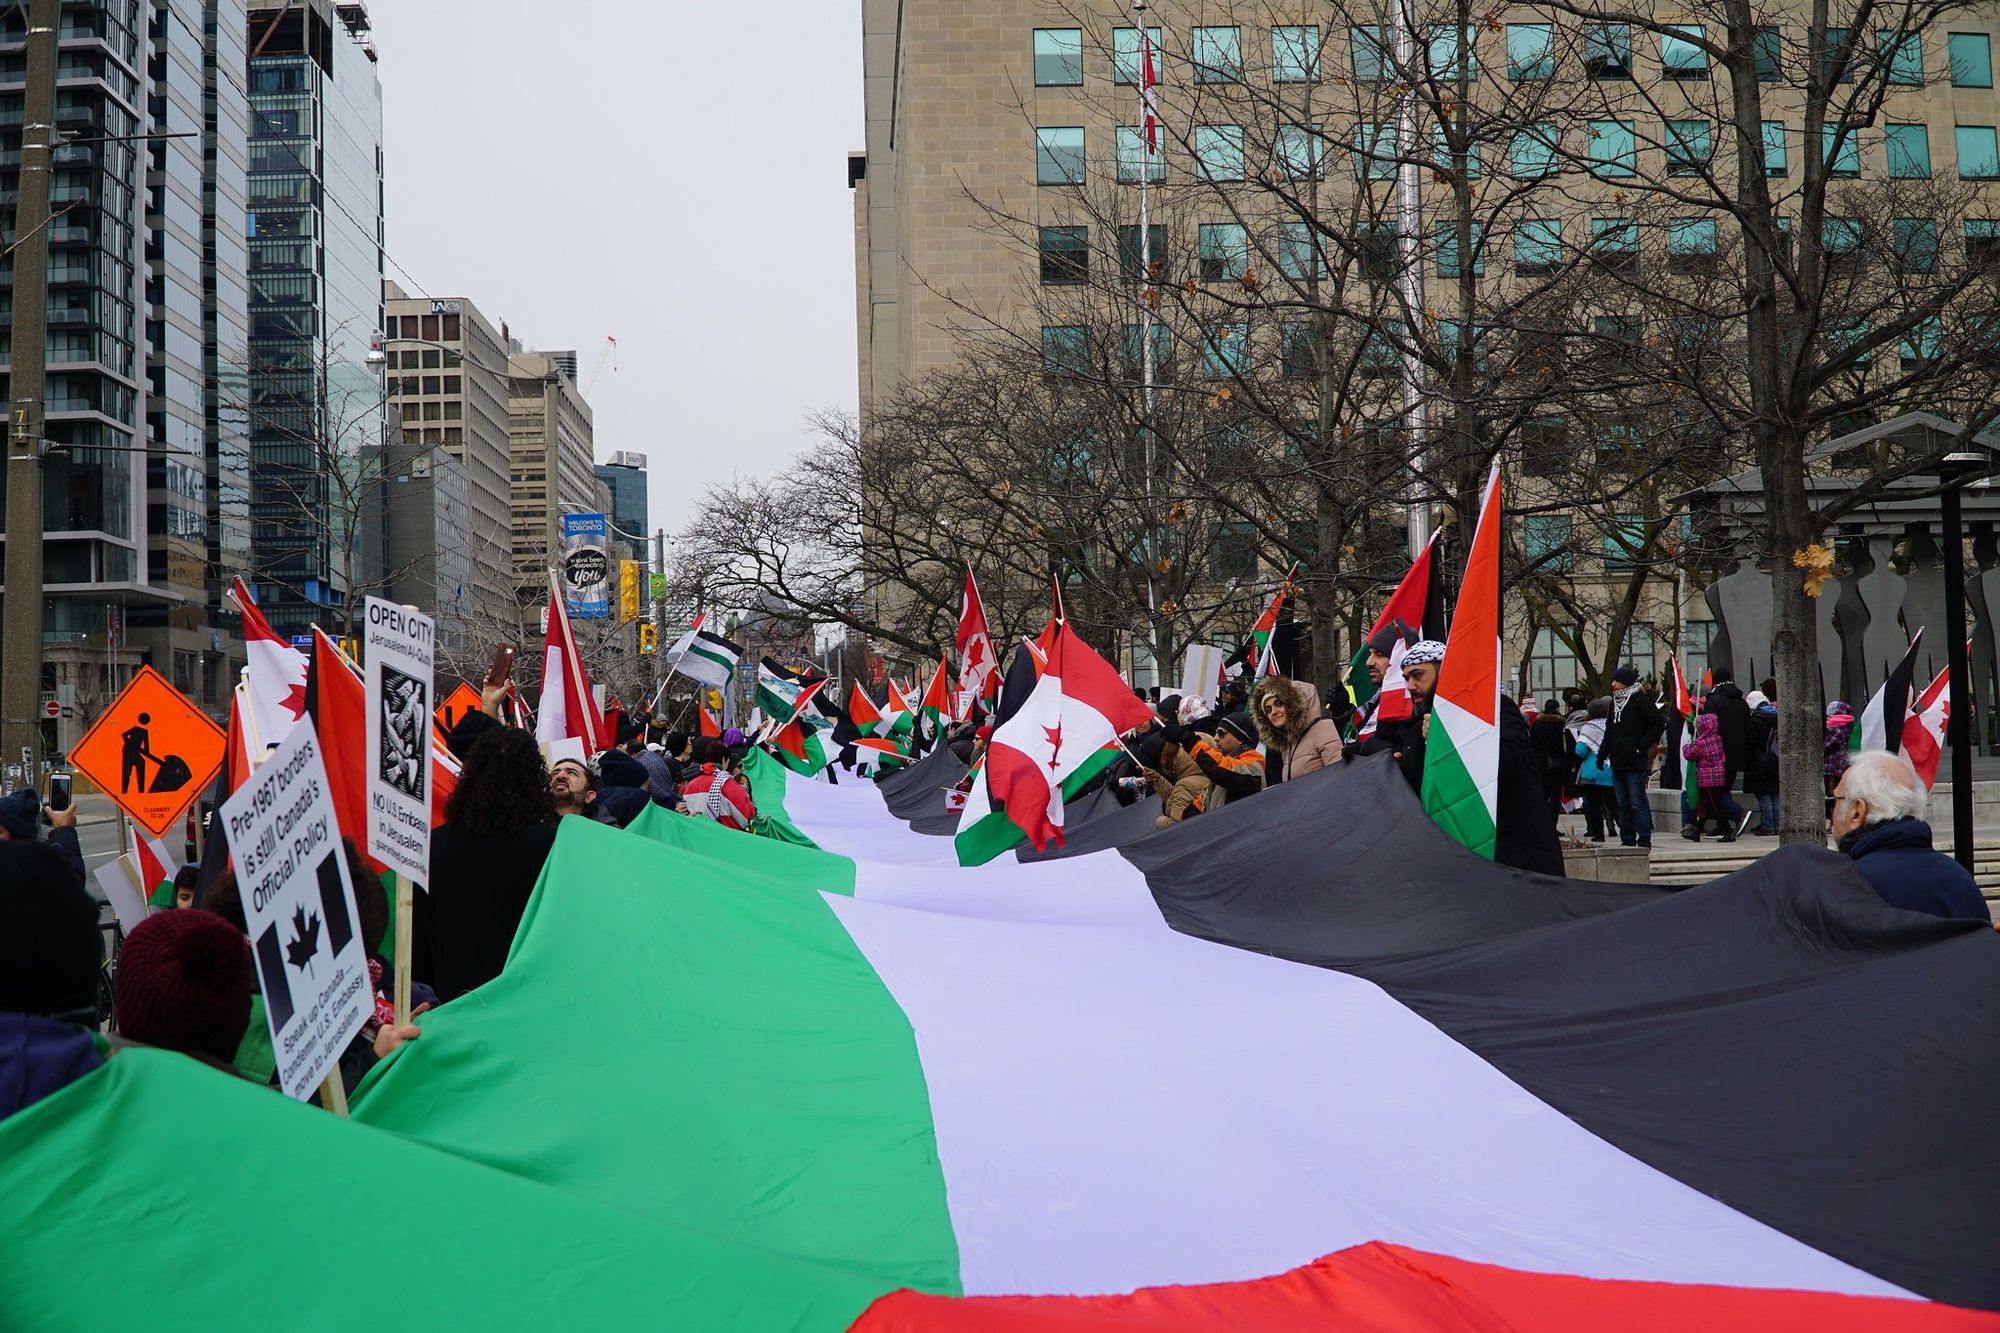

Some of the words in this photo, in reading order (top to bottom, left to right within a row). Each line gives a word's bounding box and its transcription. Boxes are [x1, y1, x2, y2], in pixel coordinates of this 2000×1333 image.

[574, 569, 601, 588] you
[370, 604, 405, 634] OPEN
[408, 617, 433, 646] CITY
[231, 774, 277, 843] Pre-1967
[276, 740, 313, 792] borders
[243, 852, 256, 878] is
[256, 824, 276, 865] still
[275, 778, 319, 840] Canada's
[373, 792, 385, 809] NO
[398, 806, 428, 839] Embassy
[379, 817, 386, 834] in
[387, 823, 424, 855] Jerusalem
[253, 849, 295, 913] Official
[294, 814, 327, 865] Policy
[283, 1016, 309, 1054] Speak
[308, 1004, 319, 1025] up
[319, 968, 345, 1008] Canada
[283, 1034, 317, 1086] Condemn
[317, 1012, 332, 1039] U.S.
[332, 972, 364, 1018] Embassy
[295, 1066, 315, 1098] move
[314, 1055, 324, 1071] to
[323, 1005, 359, 1060] Jerusalem
